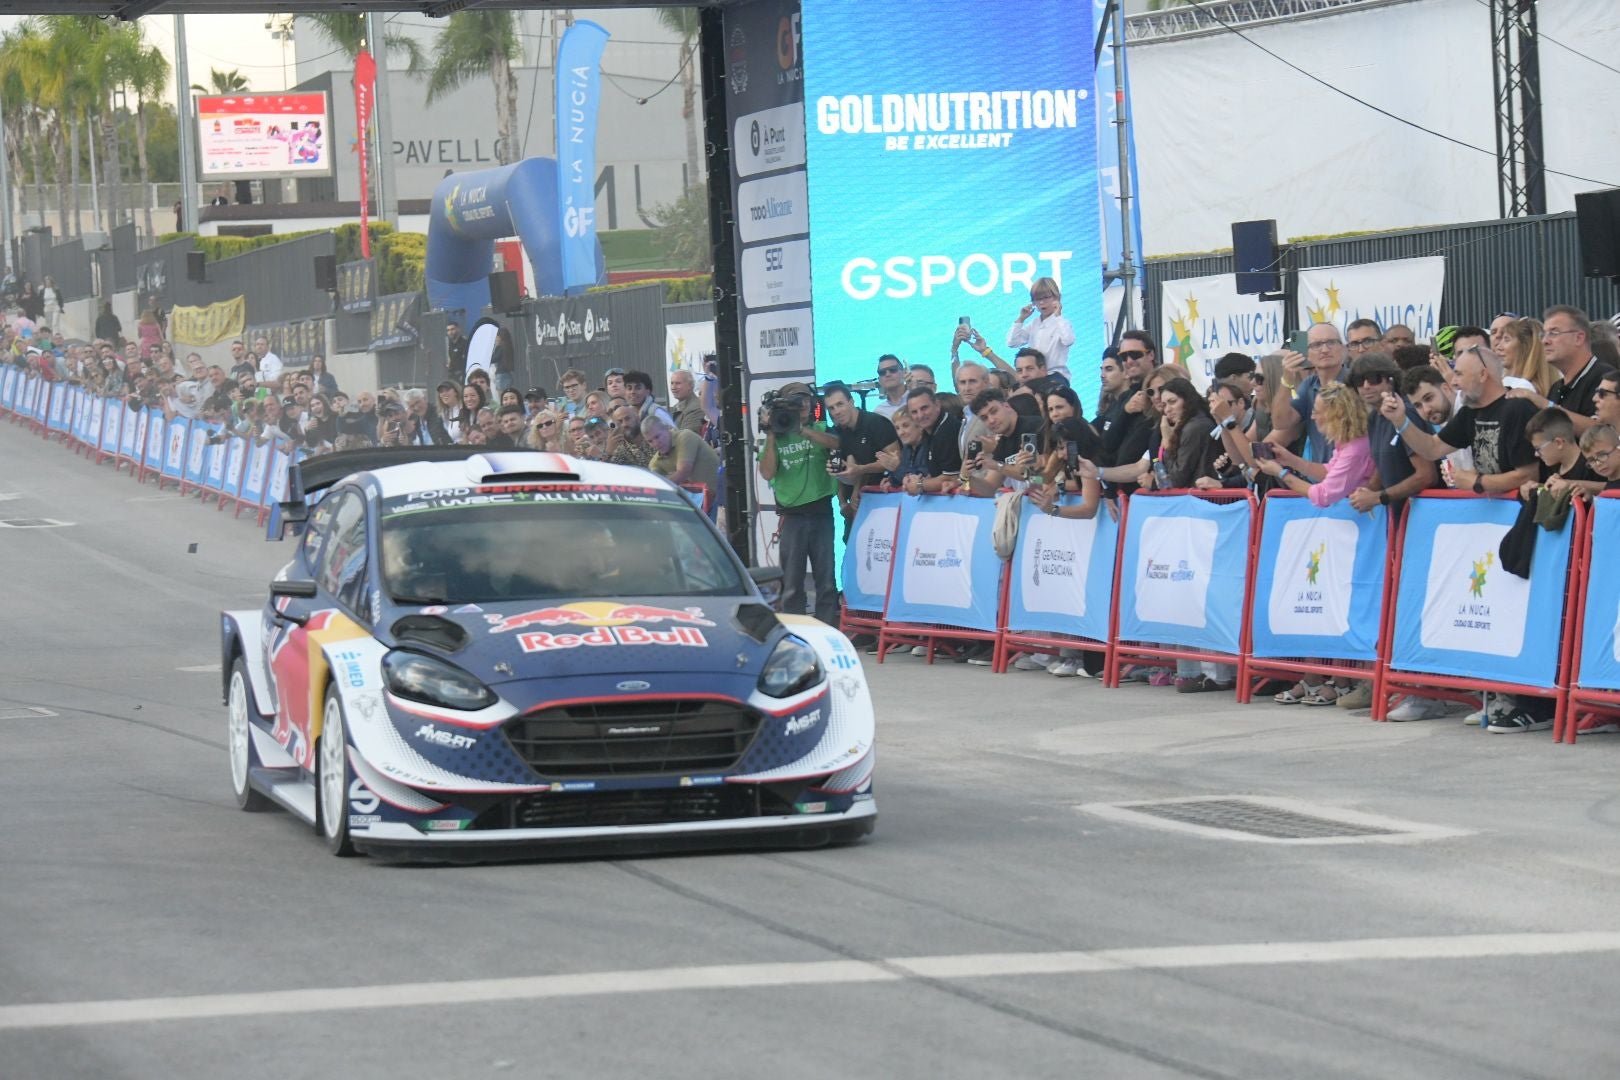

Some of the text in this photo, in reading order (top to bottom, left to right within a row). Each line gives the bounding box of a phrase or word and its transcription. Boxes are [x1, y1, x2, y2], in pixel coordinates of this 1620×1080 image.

[885, 132, 1013, 151] BE EXCELLENT
[571, 159, 583, 183] LA
[840, 250, 1073, 300] GSPORT
[1203, 316, 1220, 349] LA
[407, 484, 657, 501] FORD PERFORMANCE
[533, 493, 569, 501] ALL
[571, 493, 613, 502] LIVE
[517, 625, 709, 653] Red Bull
